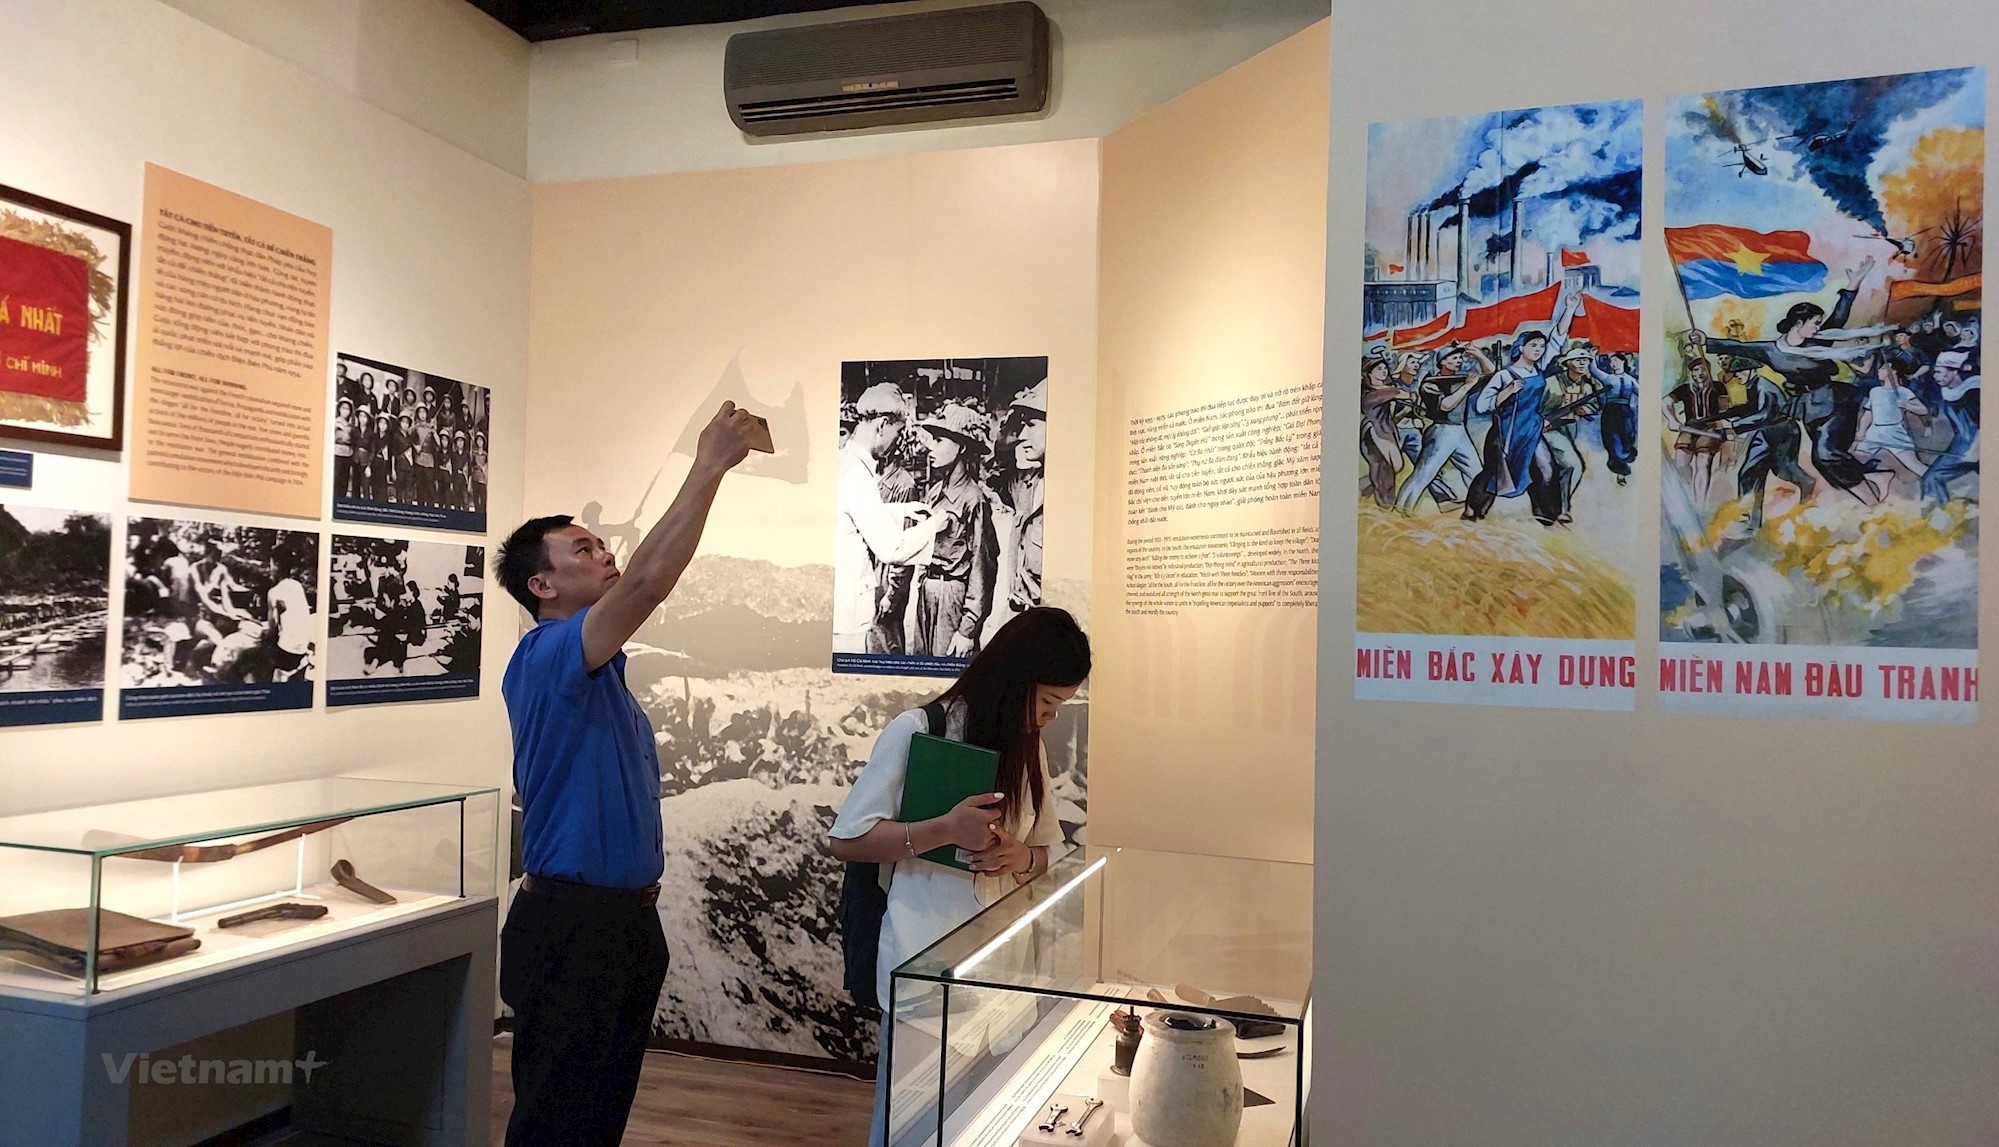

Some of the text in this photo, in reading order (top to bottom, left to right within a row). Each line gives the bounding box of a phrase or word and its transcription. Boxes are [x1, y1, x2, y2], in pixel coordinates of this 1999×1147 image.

[1559, 655, 1635, 689] DỰNG
[1735, 661, 1792, 695] NAM
[1878, 665, 1979, 701] TRANH
